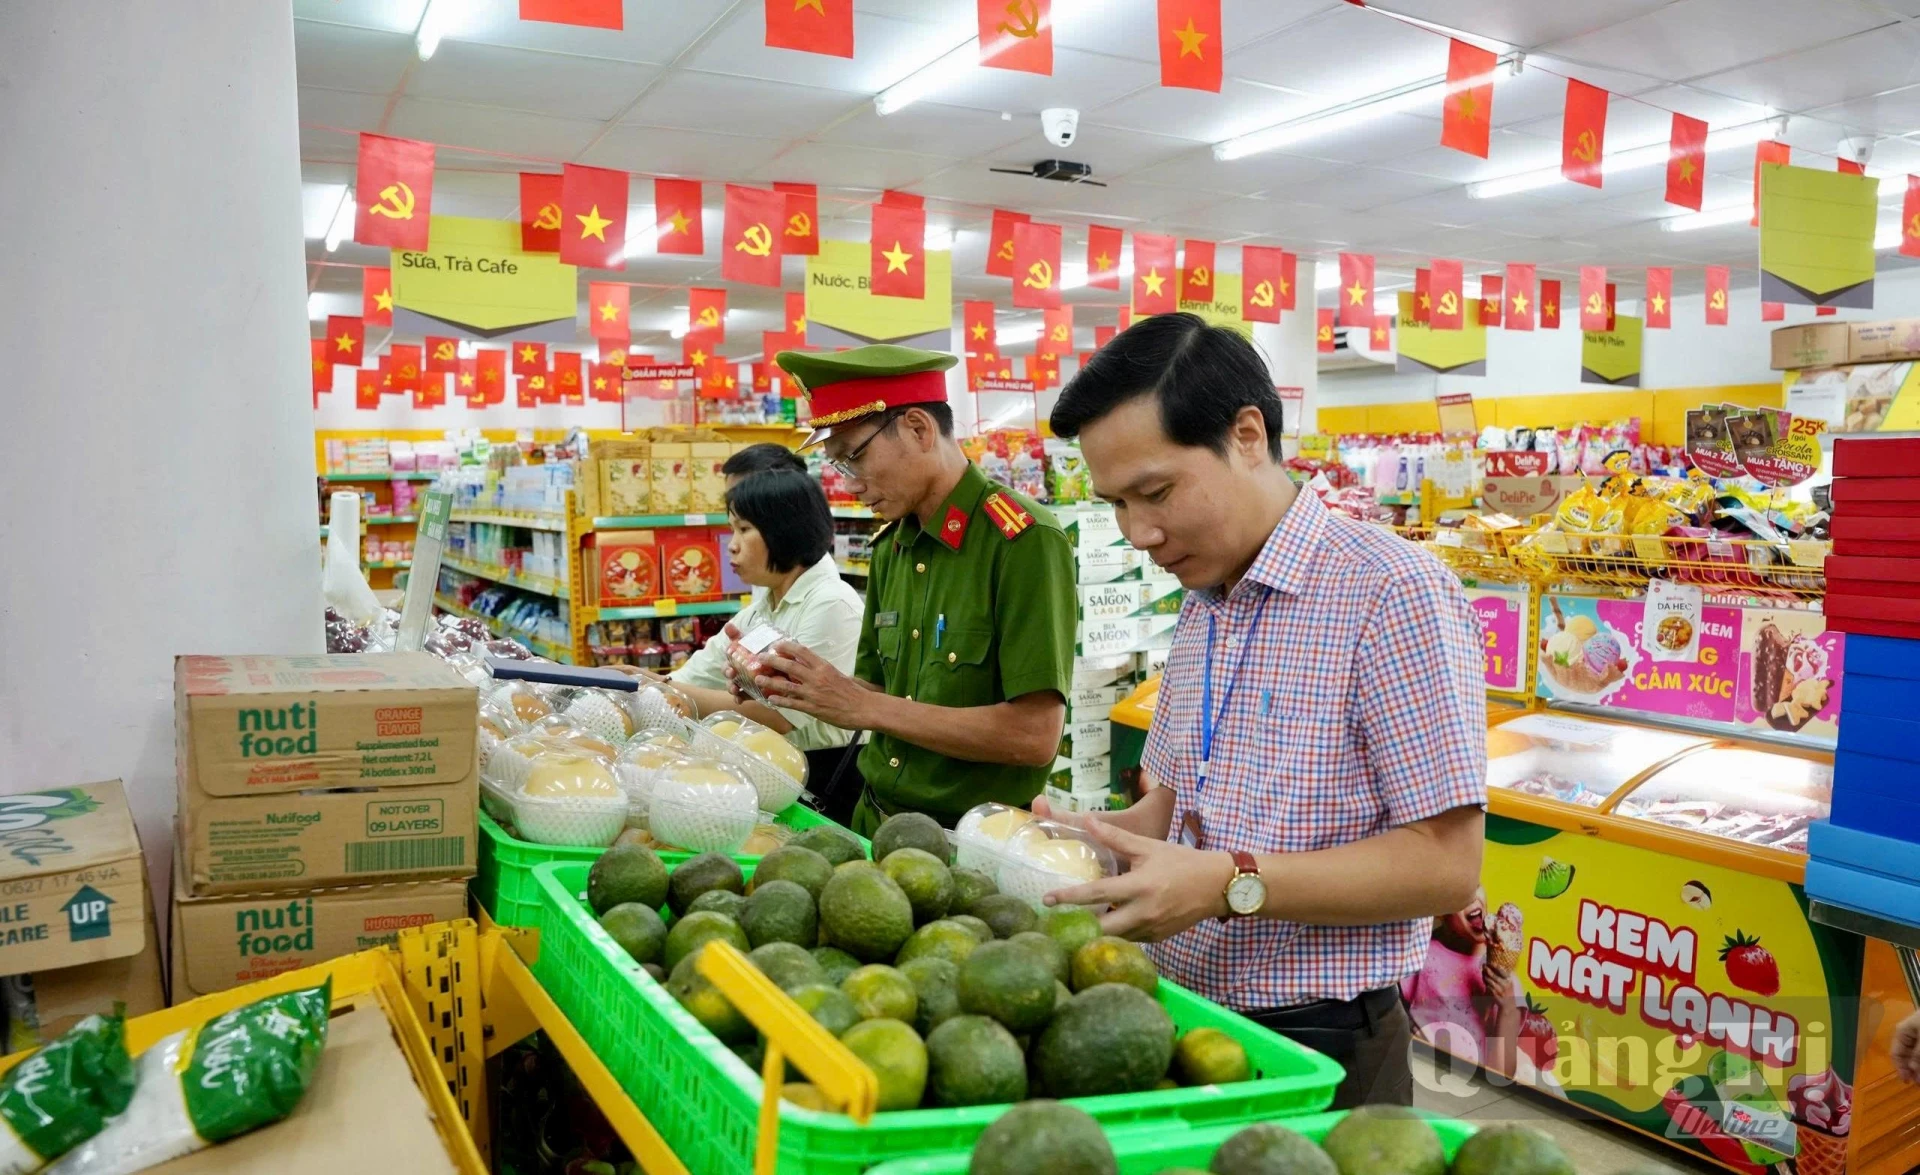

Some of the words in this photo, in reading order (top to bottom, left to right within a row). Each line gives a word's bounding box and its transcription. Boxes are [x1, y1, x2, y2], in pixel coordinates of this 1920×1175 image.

[402, 252, 440, 271] Sữa,
[444, 255, 473, 272] Trà
[477, 258, 518, 275] Cafe
[813, 272, 854, 291] Nước,
[858, 276, 873, 289] Bi
[1695, 447, 1712, 458] MUA
[1765, 446, 1813, 461] CROISSANT
[1514, 454, 1541, 466] DeliPie
[1747, 457, 1764, 465] MUA
[1772, 457, 1804, 472] TẶNG
[1500, 490, 1536, 503] DeliPie
[1089, 593, 1132, 607] SAIGON
[1657, 603, 1671, 611] DA
[1093, 606, 1129, 615] LAGER
[1479, 608, 1498, 620] Loại
[1088, 630, 1131, 643] SAIGON
[1700, 621, 1733, 639] KEM
[1485, 631, 1497, 648] 2
[1634, 666, 1682, 690] CẢM
[1687, 671, 1734, 699] XÚC
[238, 701, 317, 731] nuti
[376, 708, 421, 721] ORANGE
[378, 722, 421, 736] FLAVOR
[240, 731, 317, 757] food
[355, 739, 418, 751] Supplemented
[419, 737, 439, 747] food
[362, 755, 378, 764] Net
[428, 751, 433, 761] L
[360, 768, 370, 778] 24
[371, 767, 401, 777] bottles
[408, 766, 424, 775] 300
[425, 764, 436, 774] ml
[380, 806, 401, 815] NOT
[402, 805, 430, 814] OVER
[266, 811, 321, 824] Nutifood
[370, 822, 387, 832] 09
[390, 819, 439, 831] LAYERS
[2, 879, 44, 896] 0627
[53, 875, 70, 888] 17
[75, 870, 95, 883] 46
[71, 900, 106, 924] UP
[236, 897, 313, 932] nuti
[238, 927, 314, 956] food
[1582, 901, 1696, 974] KEM
[1532, 938, 1635, 1007] MÁT
[1644, 976, 1799, 1064] LẠNH
